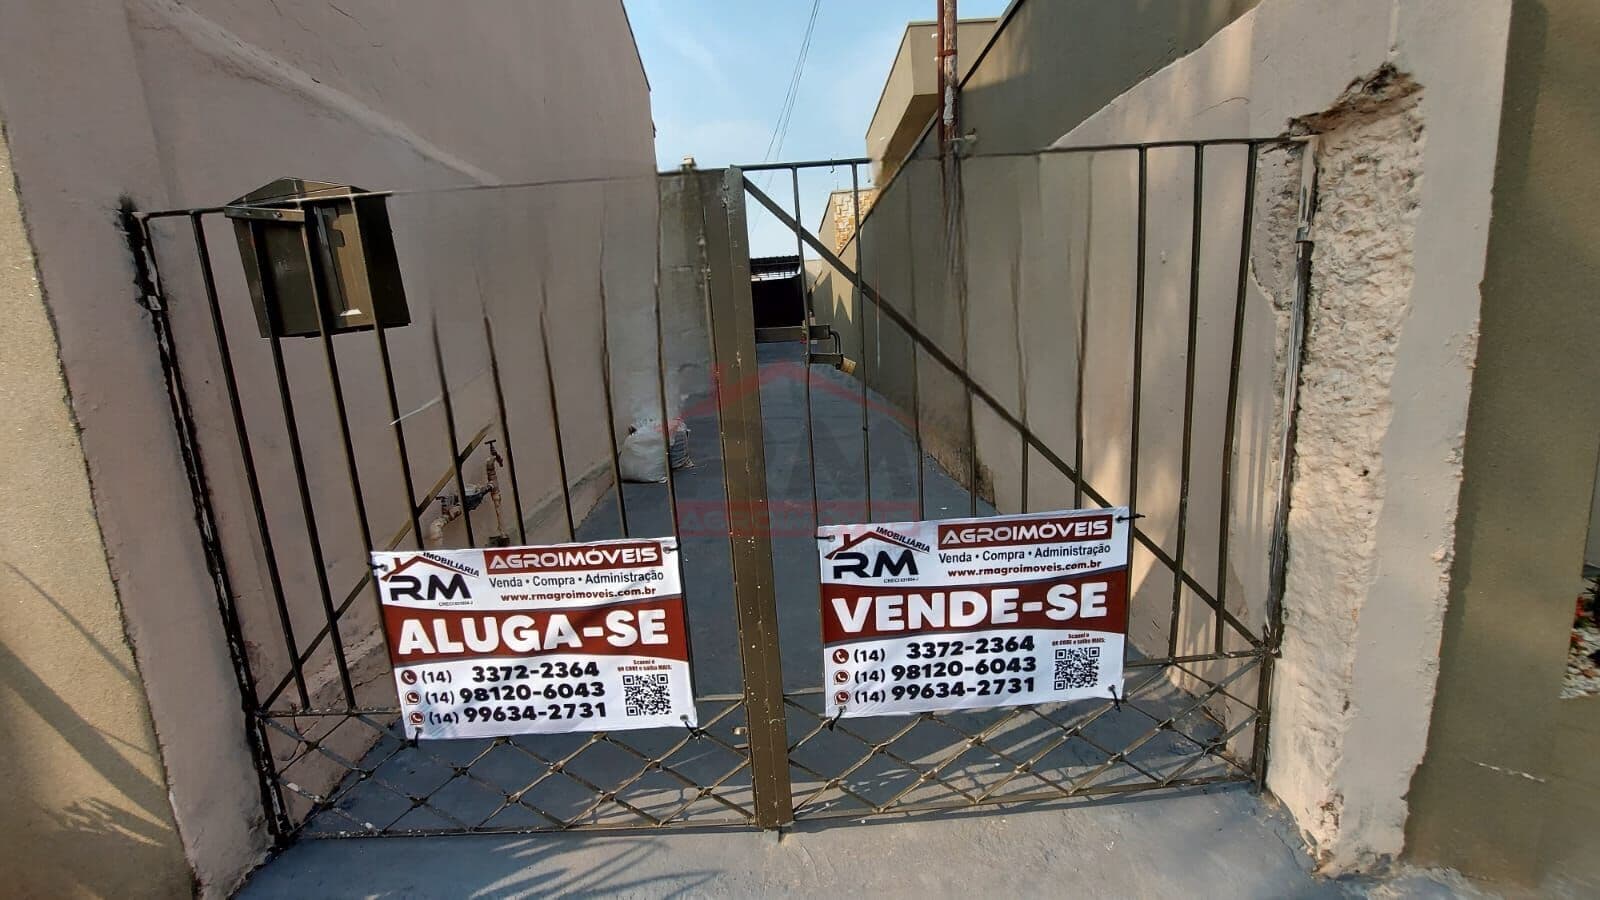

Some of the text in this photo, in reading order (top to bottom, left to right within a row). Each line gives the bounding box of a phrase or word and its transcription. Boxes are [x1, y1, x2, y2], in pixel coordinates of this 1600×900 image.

[876, 526, 930, 552] IMOBILIÁRIA
[941, 520, 1108, 545] AGROIMÓVEIS
[489, 546, 658, 570] AGROIMÓVEIS
[833, 549, 919, 579] RM
[938, 543, 1111, 564] Venda Compra Administração
[489, 568, 664, 589] Venda Compra Administração
[948, 560, 1102, 577] www.rmagroimoveis.com.br
[390, 573, 471, 601] RM
[500, 586, 657, 602] www.rmagroimoveis.com.br
[832, 581, 1108, 634] VENDE-SE
[398, 608, 669, 655] ALUGA-SE
[854, 635, 1034, 664] (14) 3372-2364
[422, 661, 600, 685] (14) 3372-2364
[854, 656, 1037, 684] (14) 98120-6043
[425, 681, 605, 705] (14) 98120-6043
[855, 677, 1034, 704] (14) 99634-2731
[428, 702, 607, 725] (14) 99634-2731
